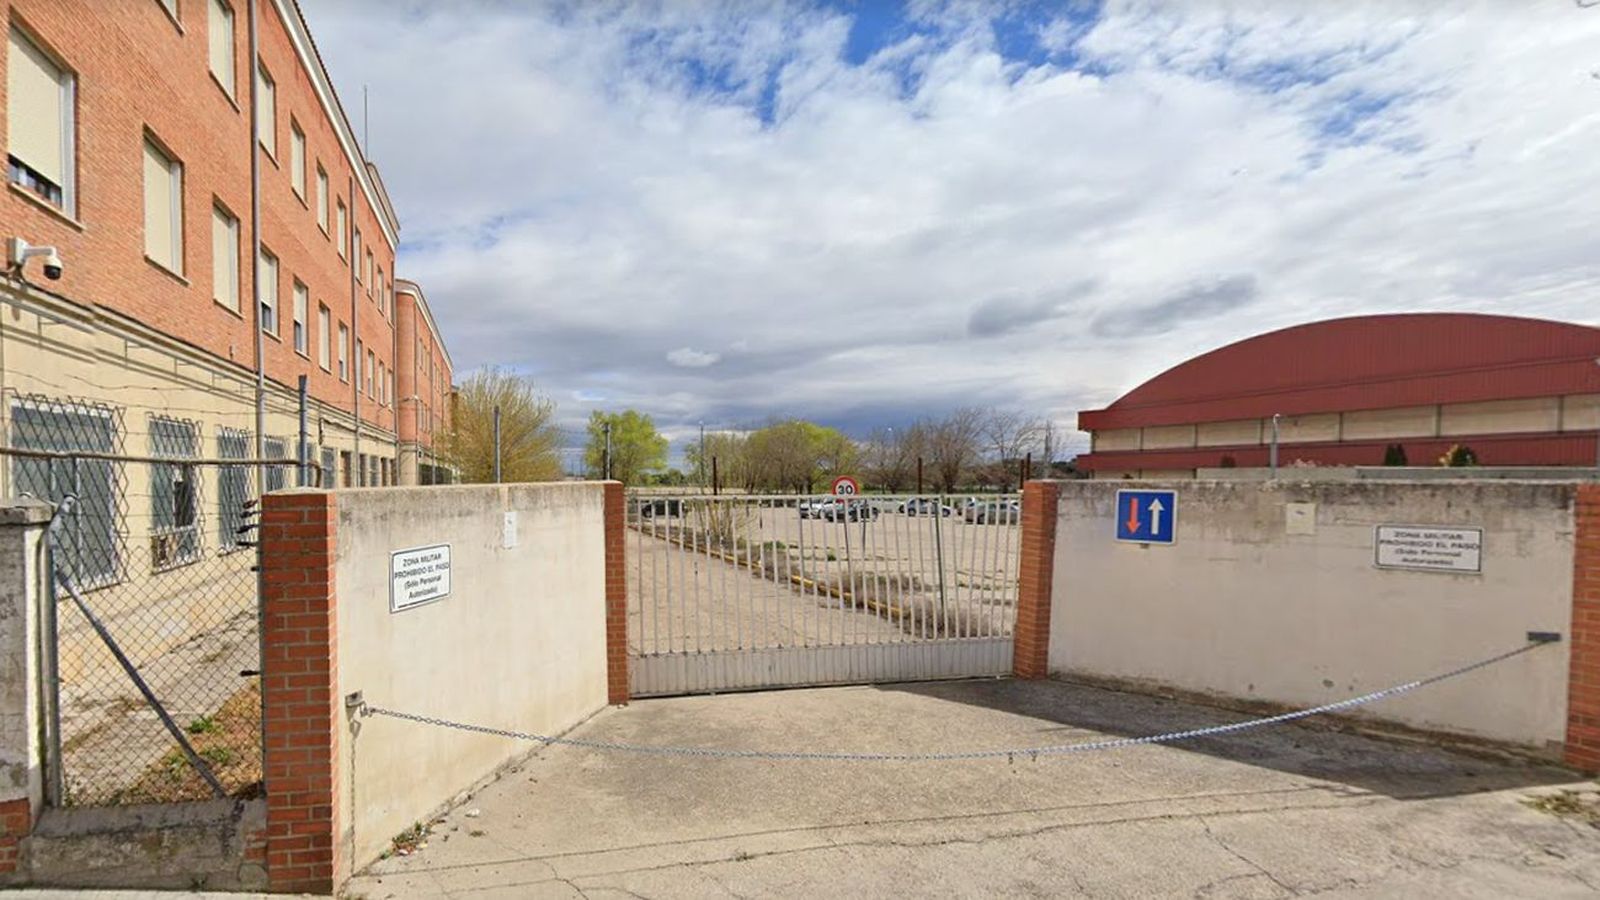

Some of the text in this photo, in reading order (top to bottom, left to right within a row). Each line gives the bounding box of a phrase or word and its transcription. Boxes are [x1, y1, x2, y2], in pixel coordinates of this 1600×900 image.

[838, 485, 853, 495] 30
[1424, 532, 1463, 540] MILITAR
[1380, 539, 1433, 548] PROHIBIDO
[1451, 542, 1480, 550] PASO
[1421, 549, 1461, 557] Personal
[403, 553, 441, 567] ZONA MILITAR
[394, 561, 449, 579] PROHIBIDO EL PASO
[420, 574, 441, 585] Personal
